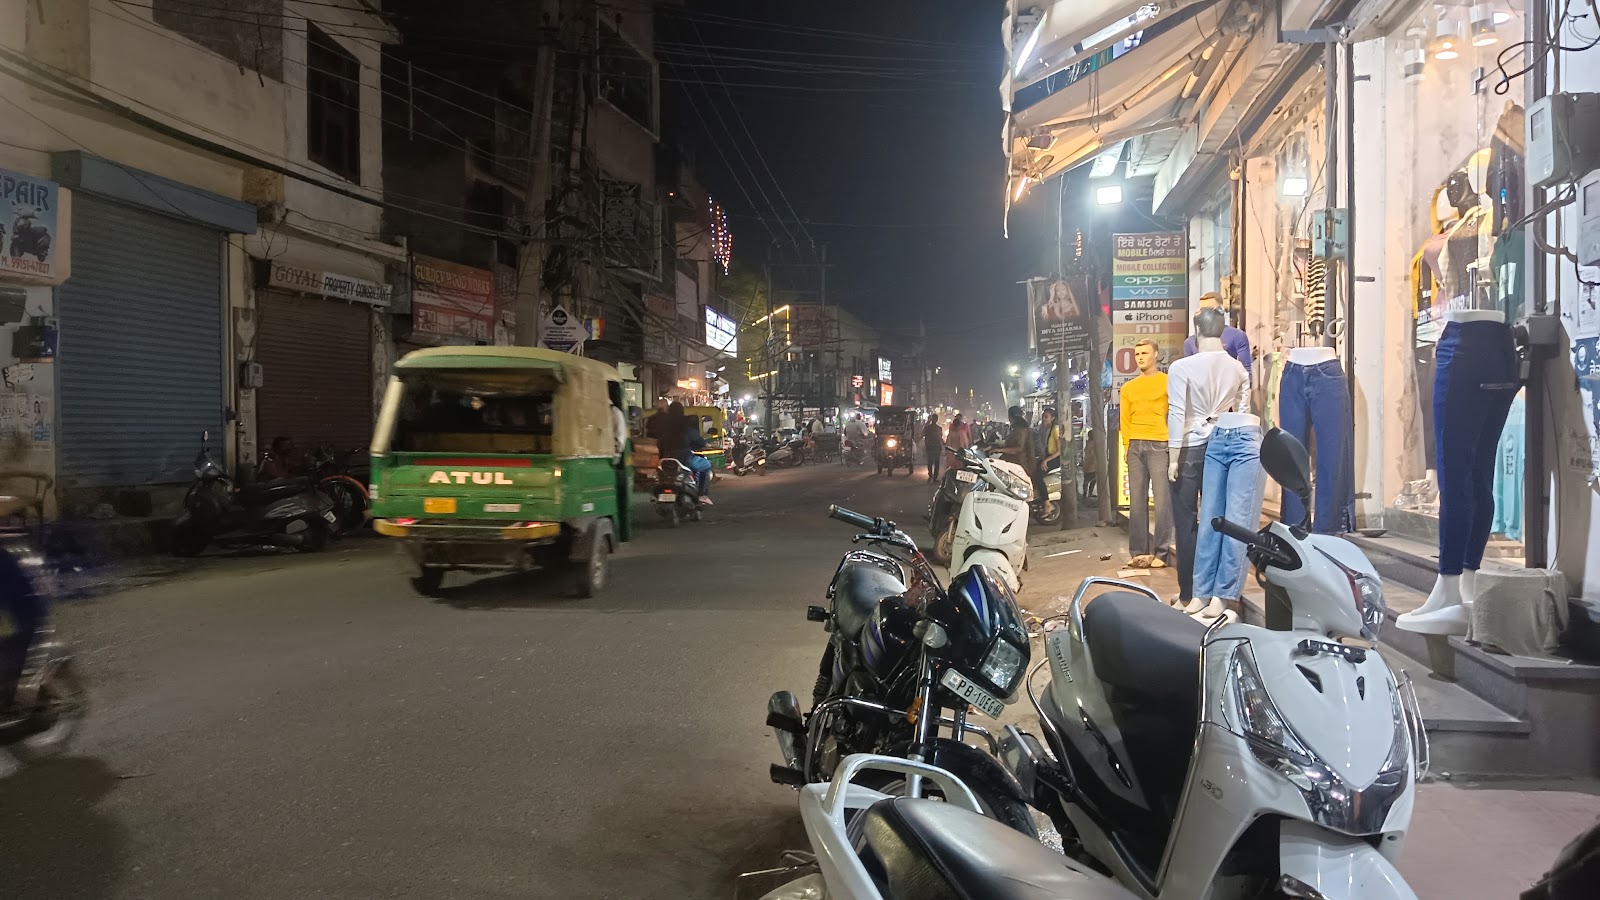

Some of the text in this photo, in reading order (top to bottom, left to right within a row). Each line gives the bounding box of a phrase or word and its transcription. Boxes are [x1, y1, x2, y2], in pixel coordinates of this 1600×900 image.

[1173, 235, 1182, 246] ਤੇ
[1118, 249, 1148, 257] MOBILE
[1117, 263, 1182, 272] MOBILE COLLECTION
[275, 265, 319, 288] GOYAL
[324, 276, 357, 295] PROPERTY
[1129, 287, 1168, 295] vivo
[1124, 300, 1173, 309] SAMSUNG
[1136, 313, 1173, 321] iPhone
[428, 470, 513, 485] ATUL
